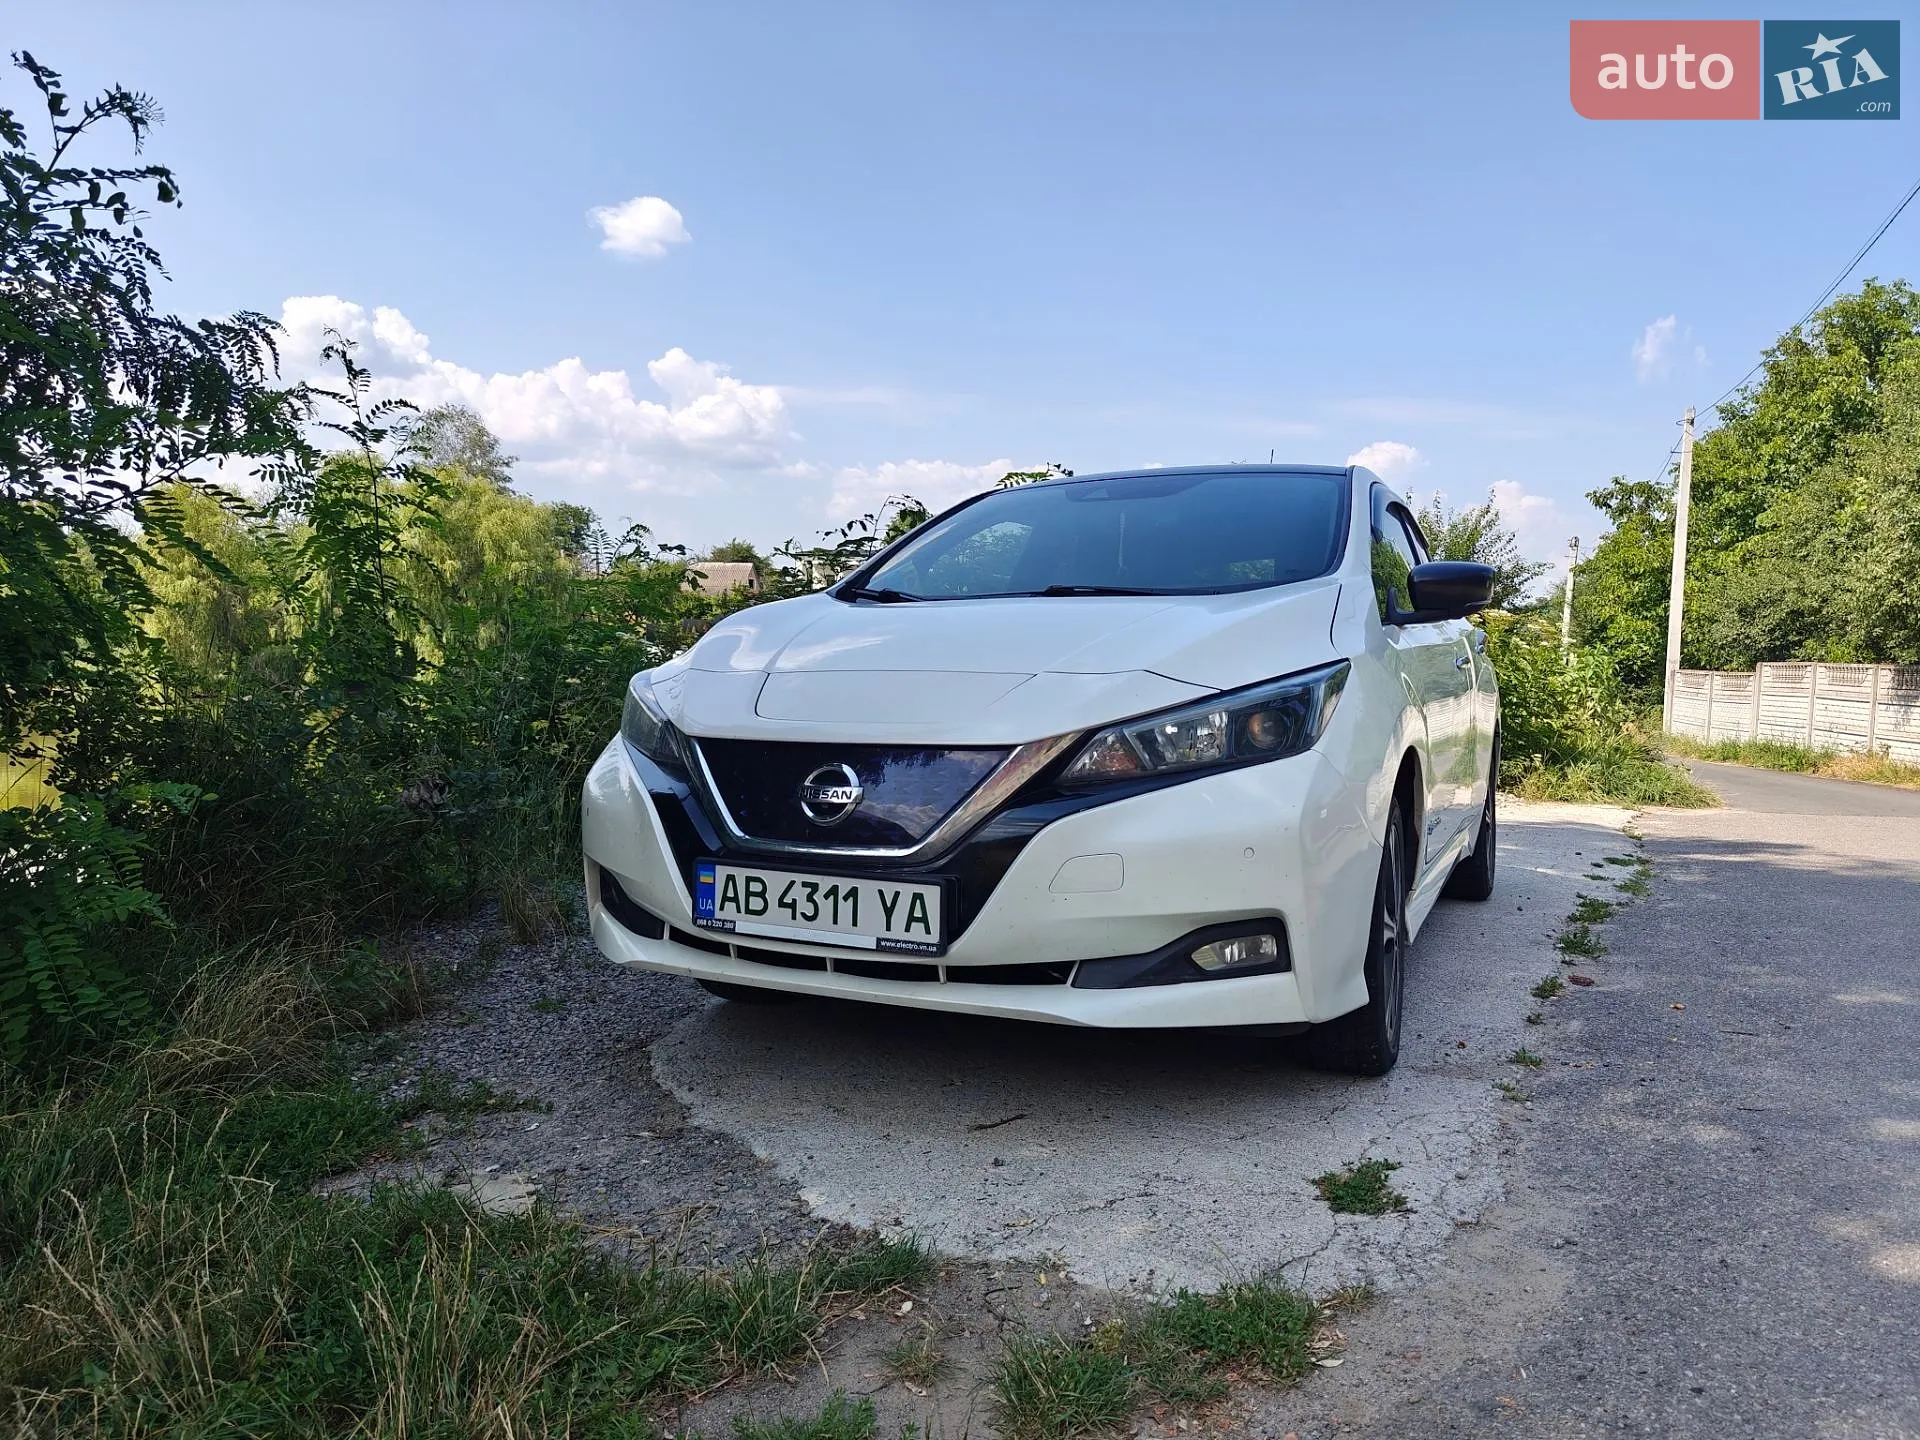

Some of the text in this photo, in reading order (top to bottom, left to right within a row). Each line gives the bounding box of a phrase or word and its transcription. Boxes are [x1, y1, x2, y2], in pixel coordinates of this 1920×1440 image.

[798, 787, 853, 800] NISSAN
[699, 897, 714, 911] UA
[718, 873, 932, 936] AB 4311 YA
